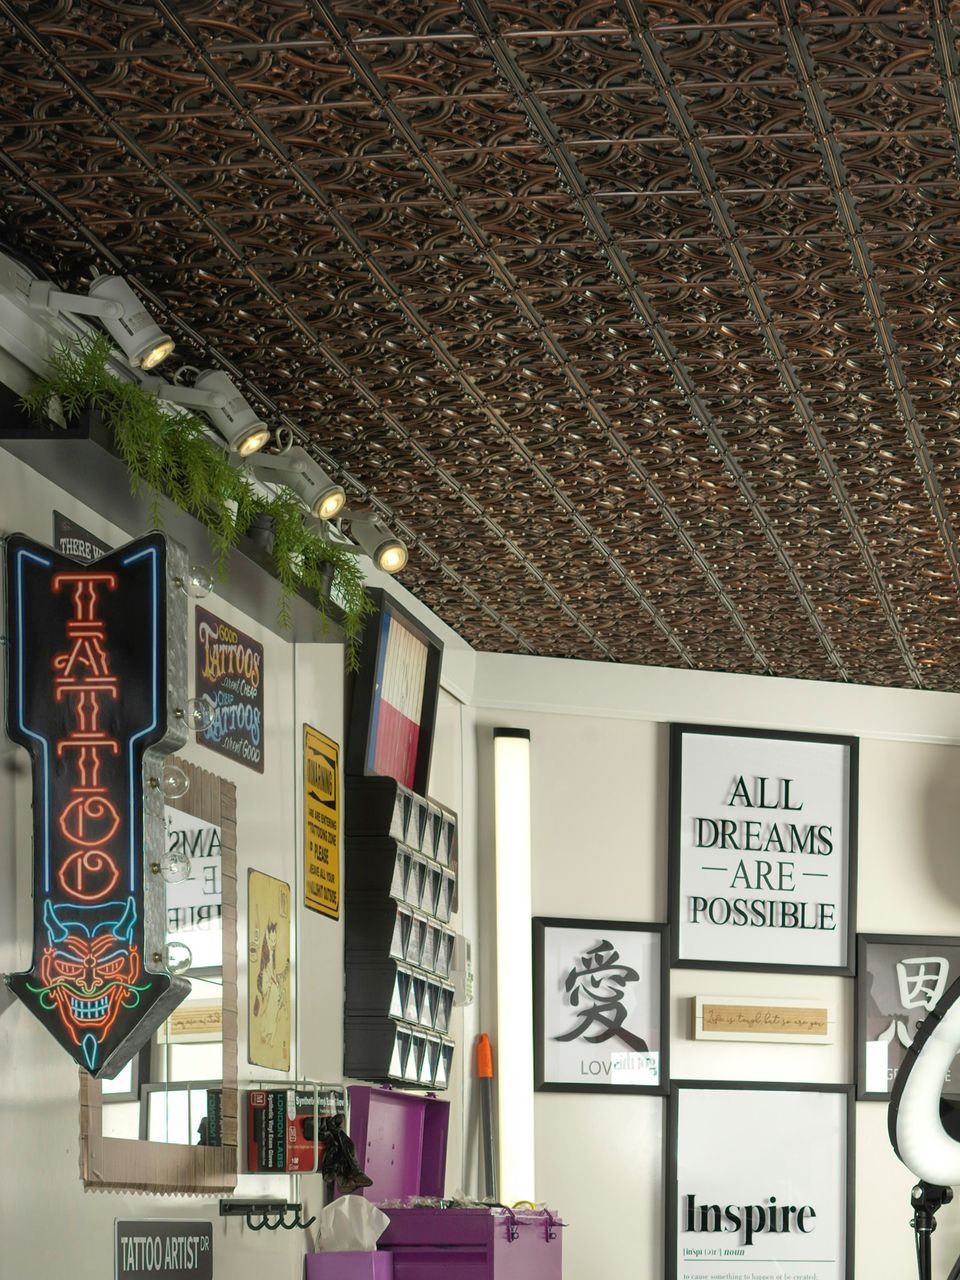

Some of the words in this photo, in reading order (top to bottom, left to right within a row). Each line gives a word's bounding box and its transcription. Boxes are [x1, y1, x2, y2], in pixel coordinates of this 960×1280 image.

[60, 538, 92, 560] THERE
[218, 624, 238, 644] GOOD
[199, 622, 261, 688] TATTOOS
[217, 690, 234, 706] CHEAP
[240, 680, 258, 700] CHEAP
[54, 574, 120, 900] TATTOO
[202, 693, 261, 746] TATTOOS
[242, 740, 260, 763] GOOD
[728, 775, 803, 811] ALL
[696, 817, 833, 856] DREAMS
[730, 859, 795, 892] ARE
[690, 896, 836, 931] POSSIBLE
[554, 939, 649, 1053] 愛
[581, 1061, 613, 1076] LOV
[687, 1194, 817, 1246] Inspire
[121, 1236, 162, 1271] TATTOO
[164, 1236, 199, 1270] ARTIST
[200, 1235, 210, 1251] DR
[710, 1272, 743, 1280] something
